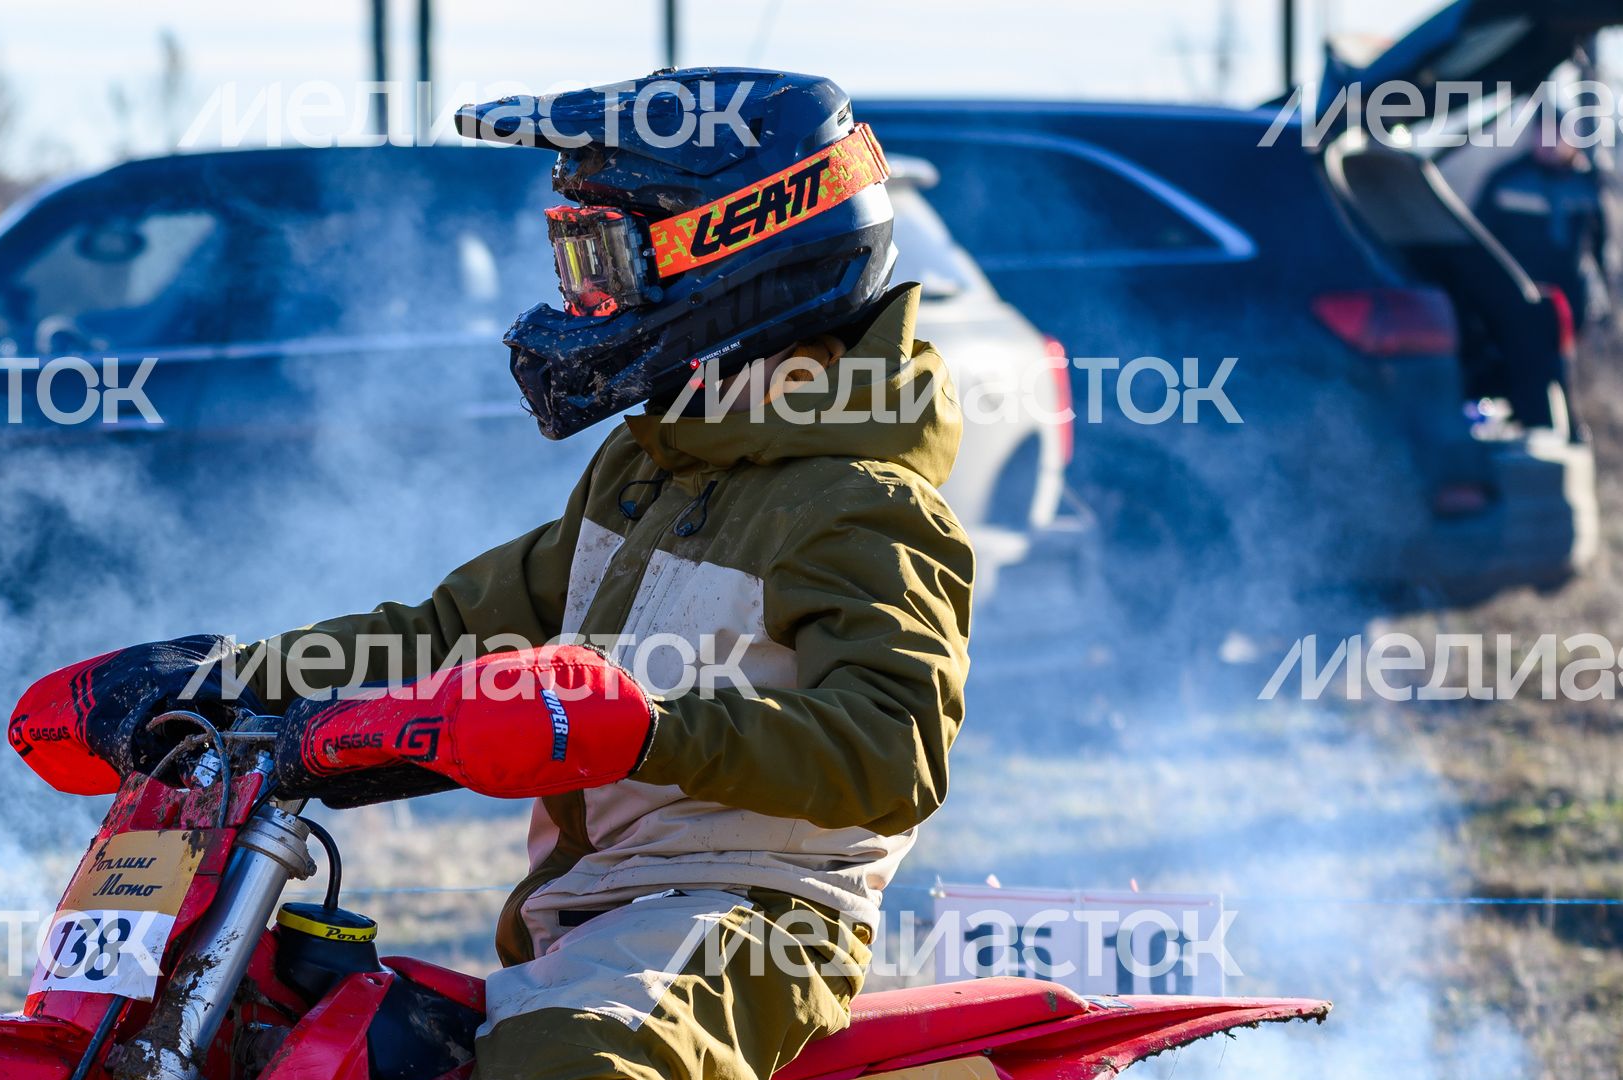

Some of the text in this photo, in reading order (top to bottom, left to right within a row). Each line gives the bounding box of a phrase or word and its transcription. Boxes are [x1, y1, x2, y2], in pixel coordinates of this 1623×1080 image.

[690, 156, 829, 257] LEATT
[29, 726, 71, 741] GASGAS
[322, 732, 384, 754] GASGAS
[88, 850, 157, 875] Роллинг
[92, 873, 163, 897] Мото
[325, 926, 377, 941] Ролли
[43, 917, 131, 981] 138
